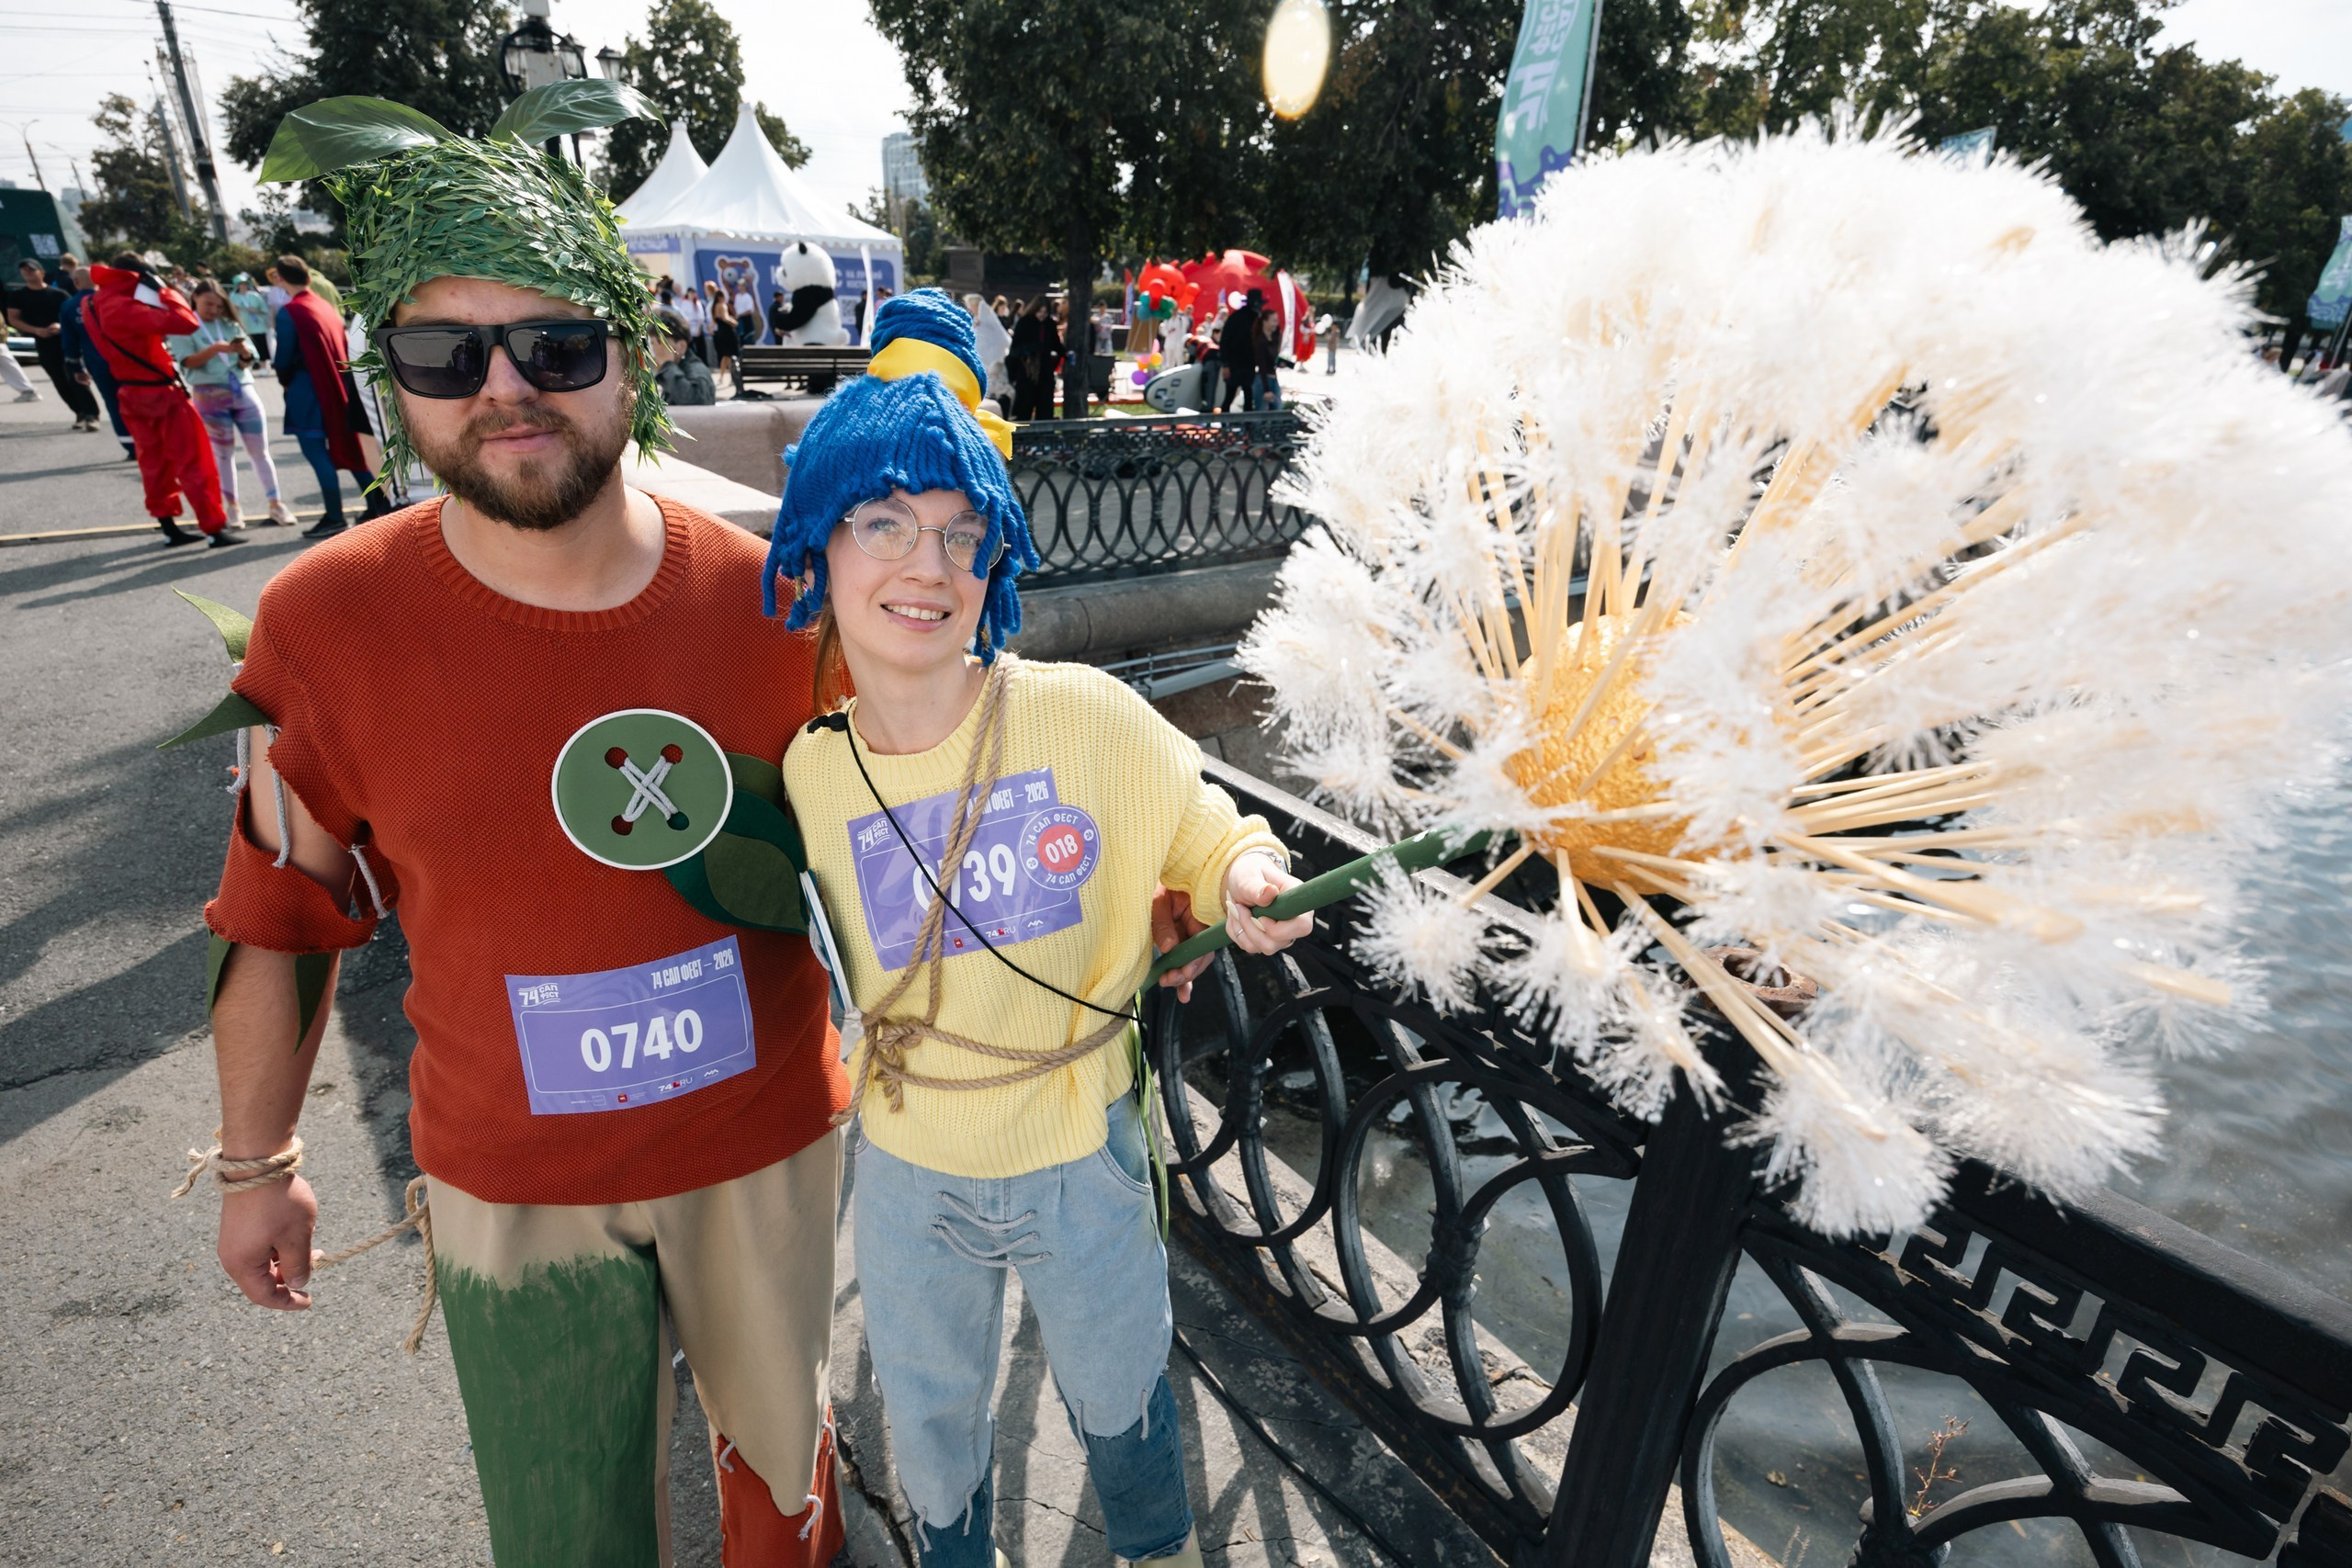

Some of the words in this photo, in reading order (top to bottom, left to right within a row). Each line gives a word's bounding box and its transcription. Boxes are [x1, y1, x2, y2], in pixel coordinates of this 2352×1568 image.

[1513, 59, 1560, 131] 74
[990, 788, 1014, 811] ФЕСТ
[1025, 781, 1049, 803] 2026
[858, 829, 874, 851] 74
[873, 820, 888, 832] САП
[874, 828, 888, 840] ФЕСТ
[1026, 834, 1036, 846] 74
[1033, 817, 1052, 833] САП
[1053, 813, 1079, 825] ФЕСТ
[1045, 834, 1079, 863] 018
[1046, 874, 1057, 885] 74
[1058, 874, 1077, 885] САП
[1076, 854, 1092, 876] ФЕСТ
[650, 971, 662, 989] 74
[662, 965, 682, 987] САП
[681, 959, 703, 981] ФЕСТ
[713, 948, 734, 970] 2026
[518, 989, 539, 1006] 74
[539, 985, 559, 993] САП
[581, 1009, 704, 1072] 0740
